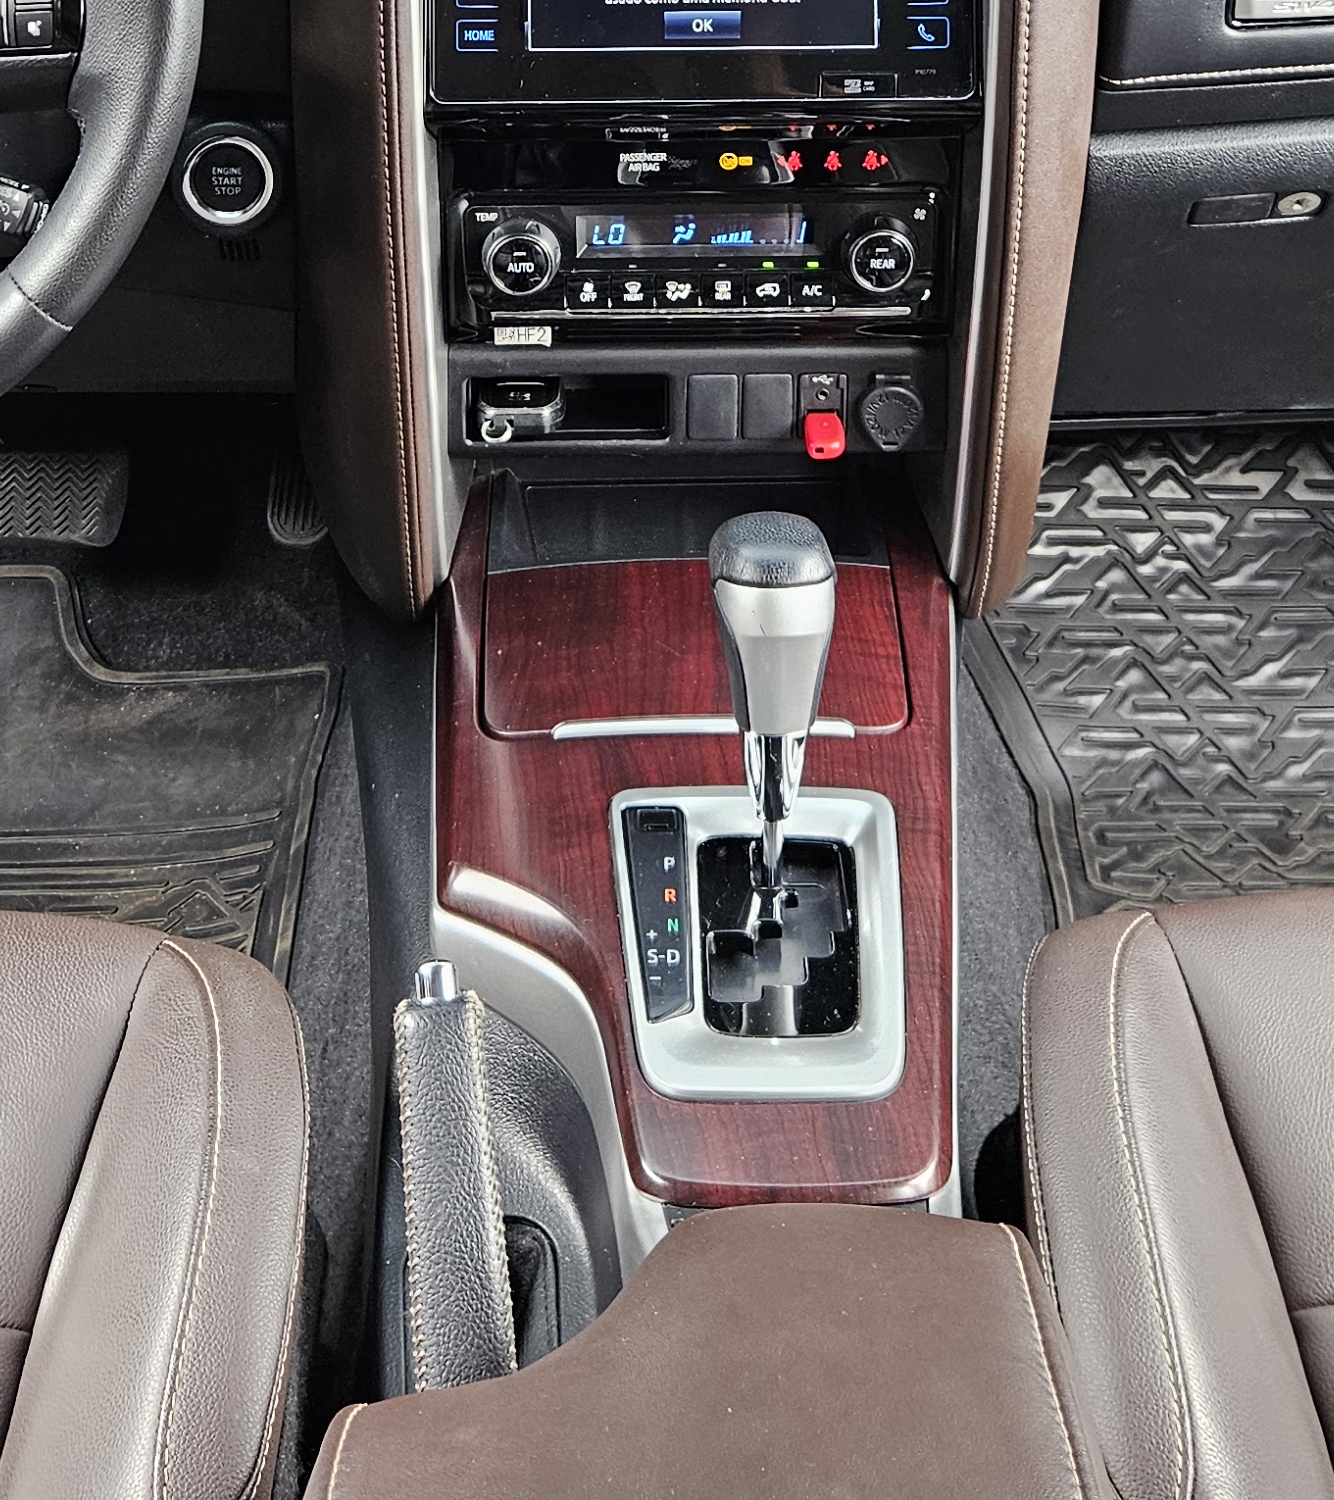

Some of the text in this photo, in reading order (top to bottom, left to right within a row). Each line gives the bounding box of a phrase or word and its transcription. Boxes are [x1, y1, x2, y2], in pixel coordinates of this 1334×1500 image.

[692, 18, 714, 32] OK
[463, 30, 495, 41] HOME
[619, 152, 667, 163] PASSENGER
[212, 166, 243, 175] ENGINE
[212, 176, 243, 185] START
[215, 186, 242, 196] STOP
[475, 212, 499, 222] TEMP
[592, 223, 626, 245] LO
[507, 262, 535, 273] AUTO
[870, 258, 896, 269] REAR
[802, 284, 823, 297] A/C
[579, 292, 597, 302] OFF
[517, 326, 548, 342] HF2
[663, 856, 676, 871] P
[664, 888, 677, 903] R
[667, 918, 679, 933] N
